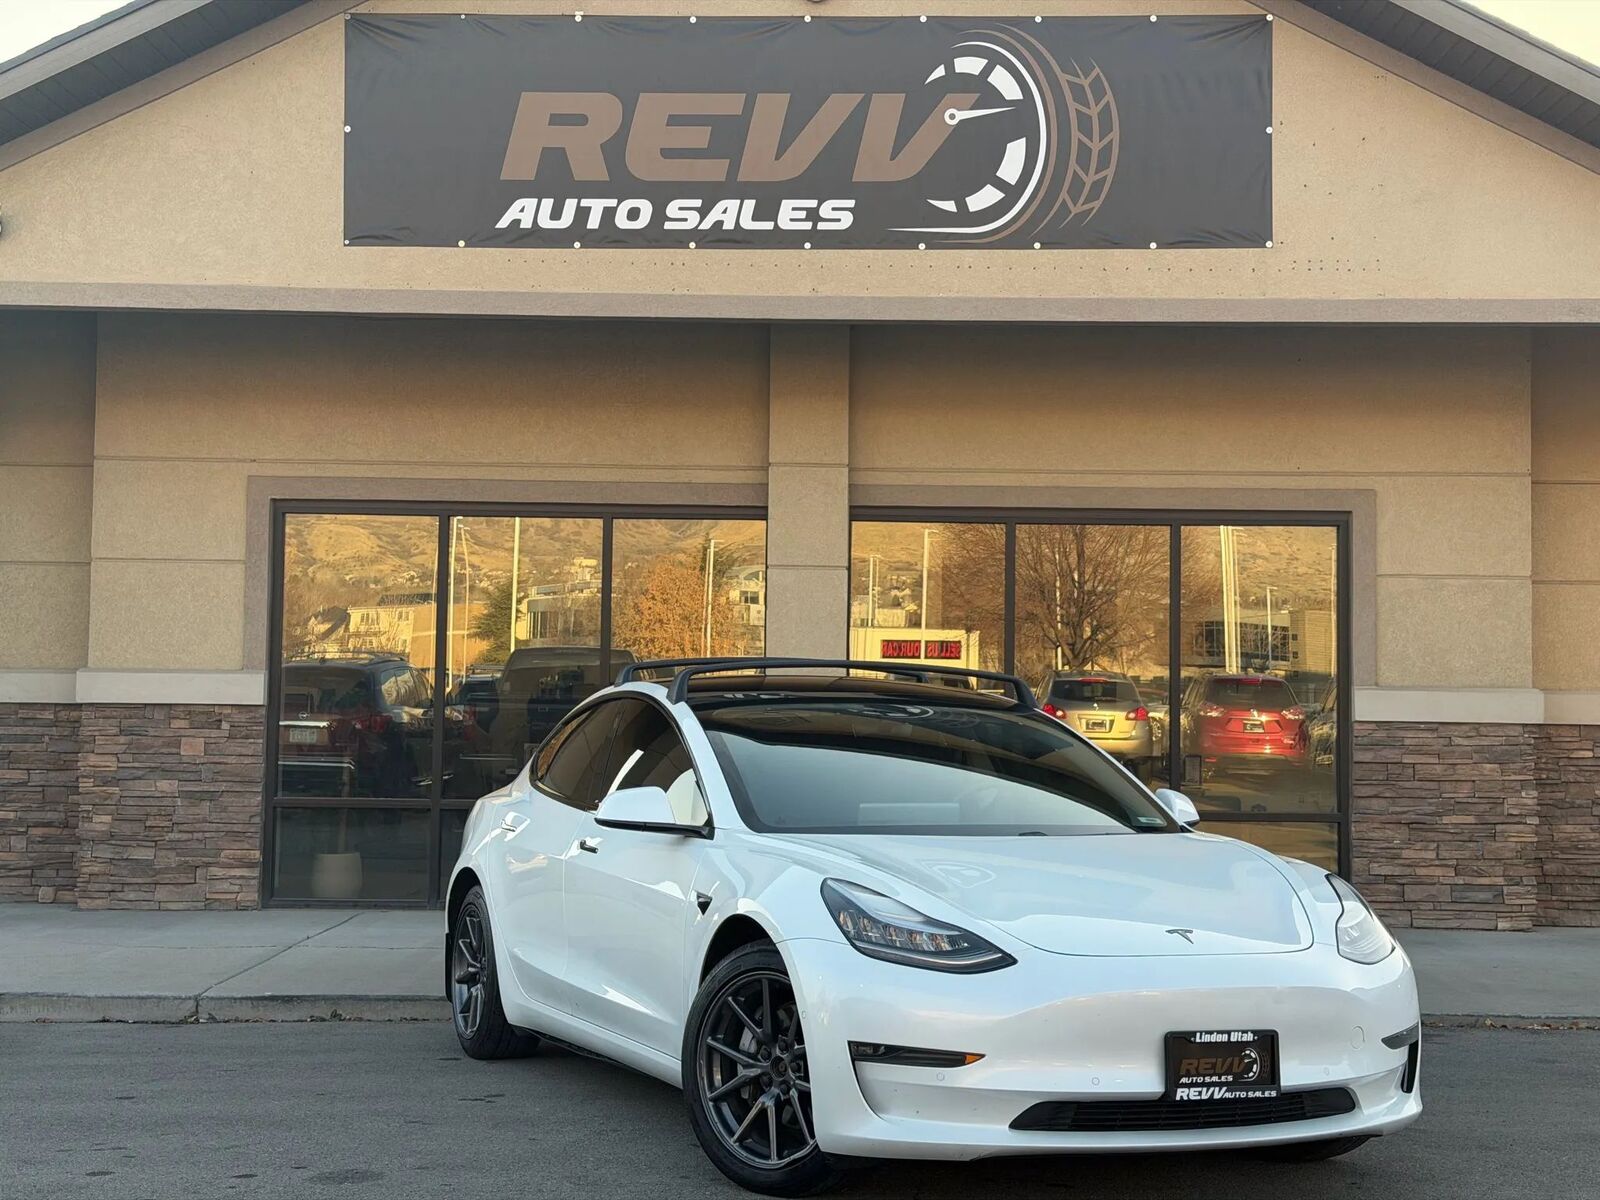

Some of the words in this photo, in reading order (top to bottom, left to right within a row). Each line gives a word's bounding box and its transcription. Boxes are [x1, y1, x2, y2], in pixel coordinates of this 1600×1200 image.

[499, 91, 981, 182] REVV
[495, 197, 653, 231] AUTO
[662, 198, 856, 231] SALES
[1195, 1032, 1228, 1042] Lindon
[1230, 1031, 1254, 1042] Utah
[1180, 1057, 1247, 1074] REVV
[1179, 1076, 1203, 1084] AUTO
[1175, 1087, 1227, 1100] REVV
[1223, 1091, 1247, 1099] AUTO
[1247, 1090, 1277, 1098] SALES
